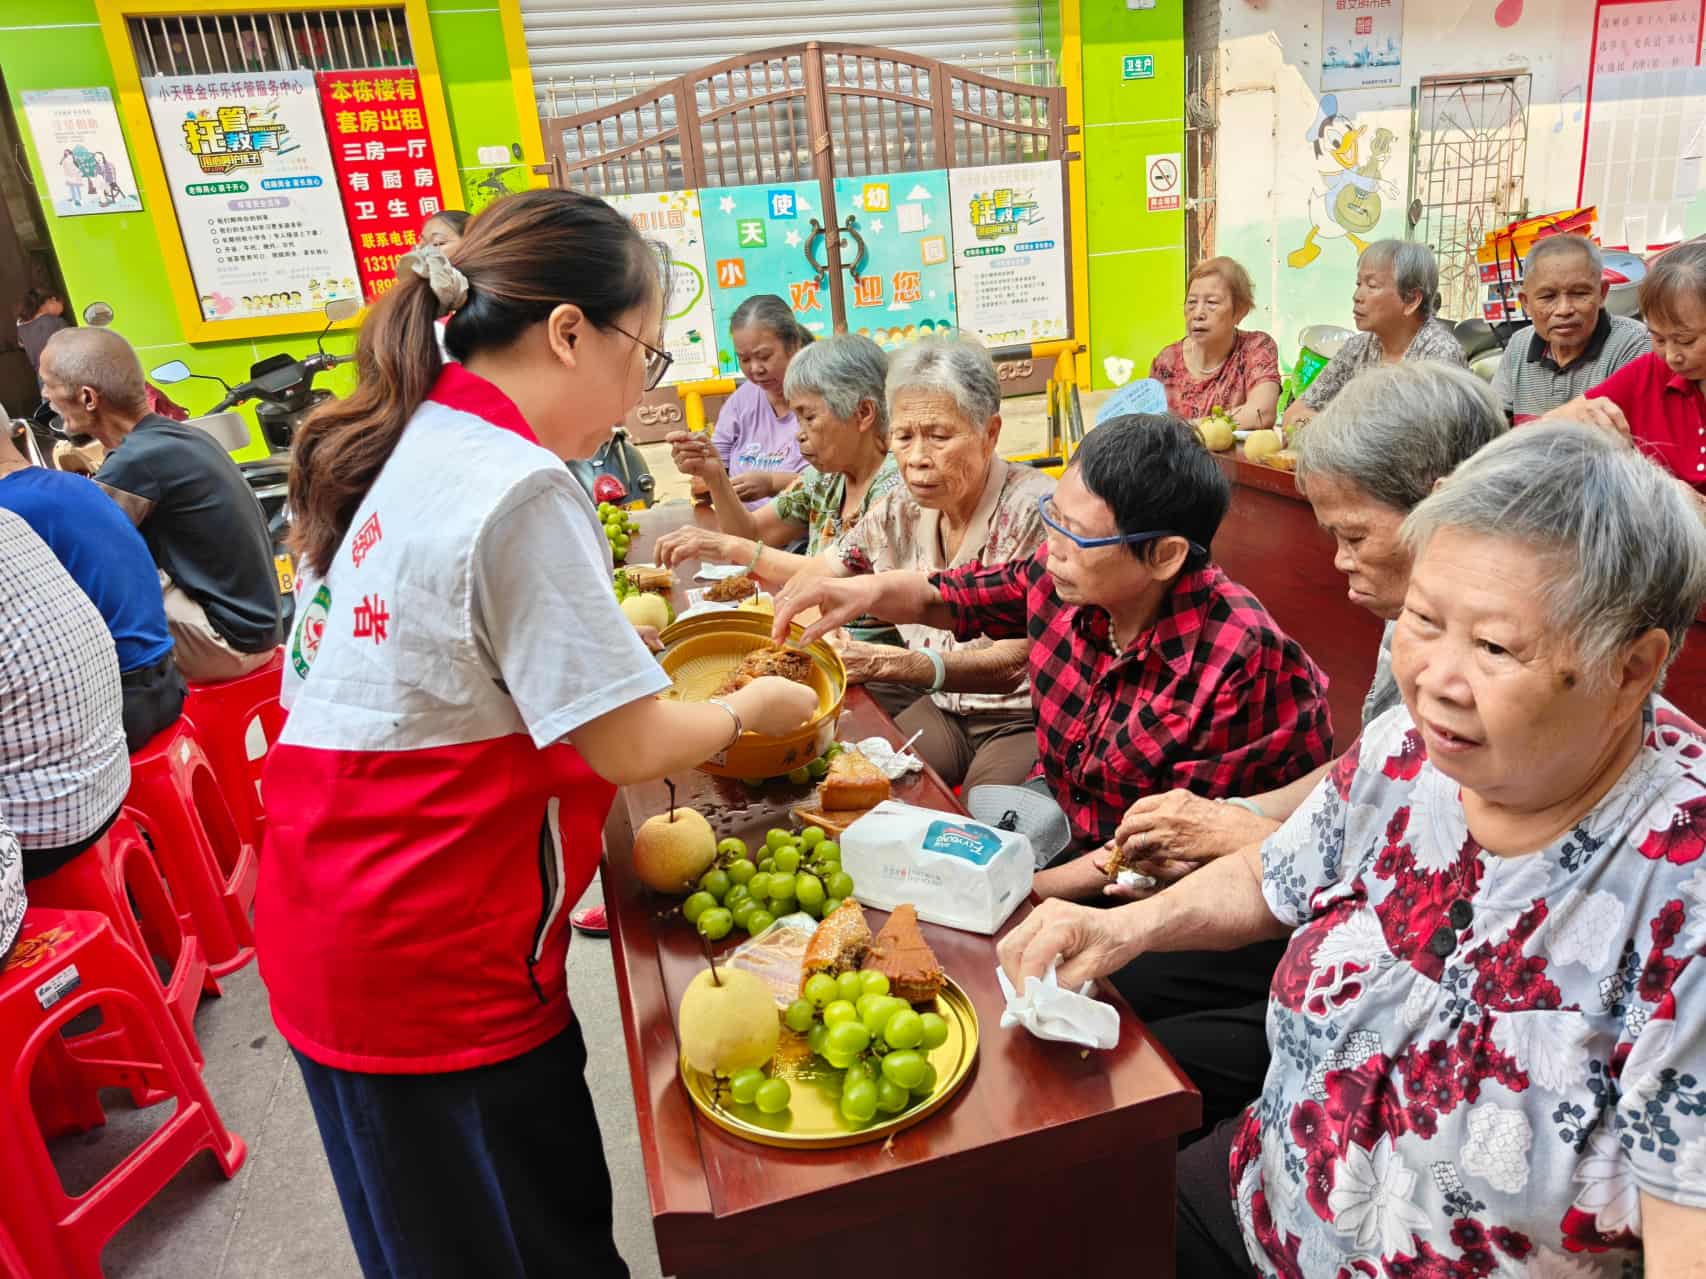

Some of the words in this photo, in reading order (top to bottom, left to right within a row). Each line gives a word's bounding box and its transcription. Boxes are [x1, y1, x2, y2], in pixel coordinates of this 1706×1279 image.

[330, 78, 417, 103] 本栋楼有
[335, 108, 425, 134] 套房出租
[343, 139, 427, 162] 三房一厅
[348, 168, 434, 192] 有厨房
[354, 196, 440, 220] 卫生间
[360, 230, 417, 248] 联系电话
[369, 278, 398, 295] 189
[789, 271, 922, 312] 欢迎您
